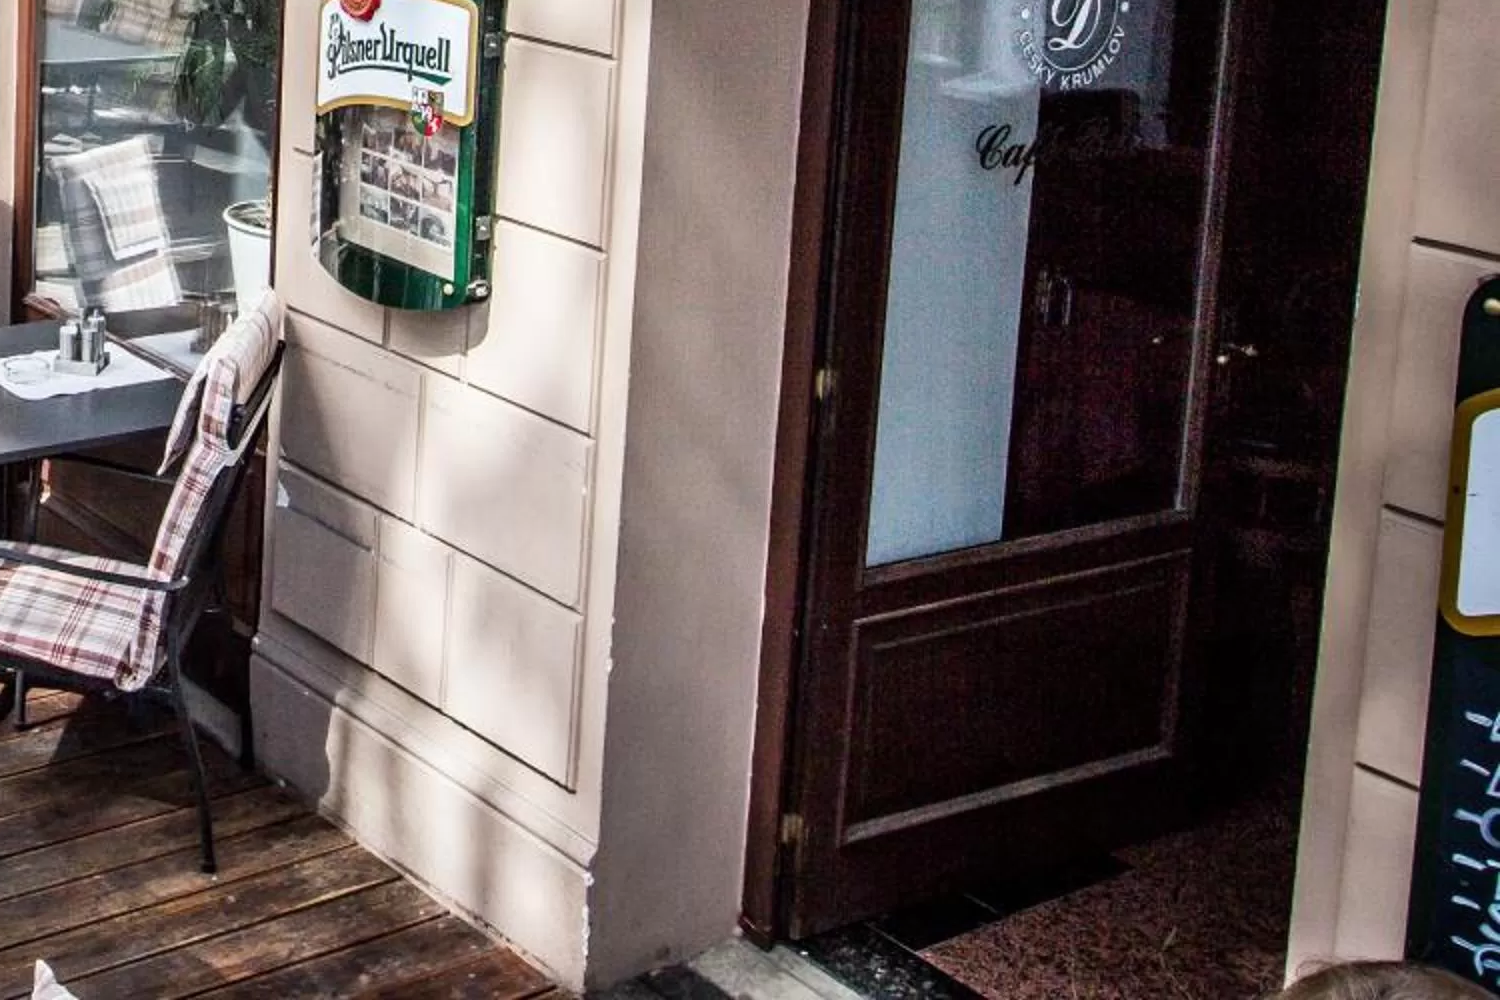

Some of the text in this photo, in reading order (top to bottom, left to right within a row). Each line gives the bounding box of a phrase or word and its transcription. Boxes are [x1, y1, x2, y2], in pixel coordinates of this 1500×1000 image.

[327, 12, 451, 82] Pilsner Urquell
[1059, 25, 1125, 91] KRUMLOV
